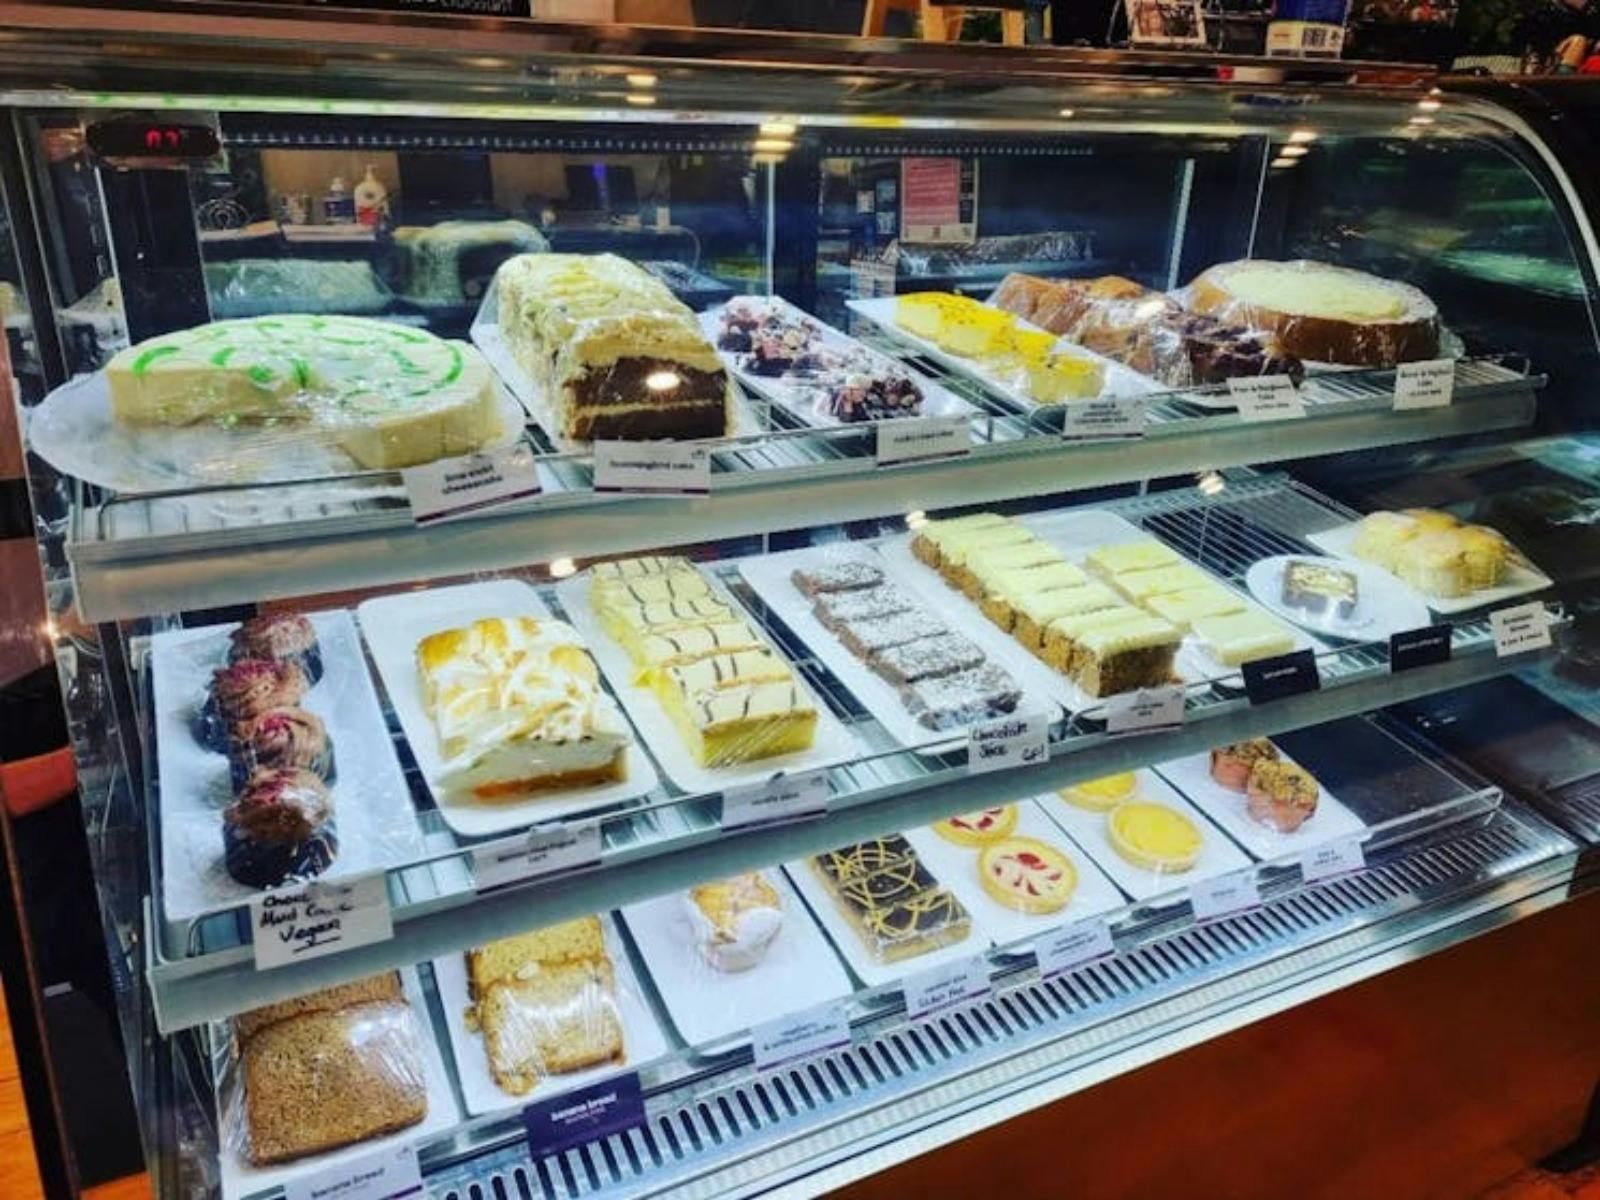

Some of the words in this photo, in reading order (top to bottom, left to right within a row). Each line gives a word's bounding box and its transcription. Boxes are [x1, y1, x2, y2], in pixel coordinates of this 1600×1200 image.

[587, 1092, 617, 1109] bread
[310, 1180, 352, 1199] banana
[353, 1167, 386, 1184] bread
